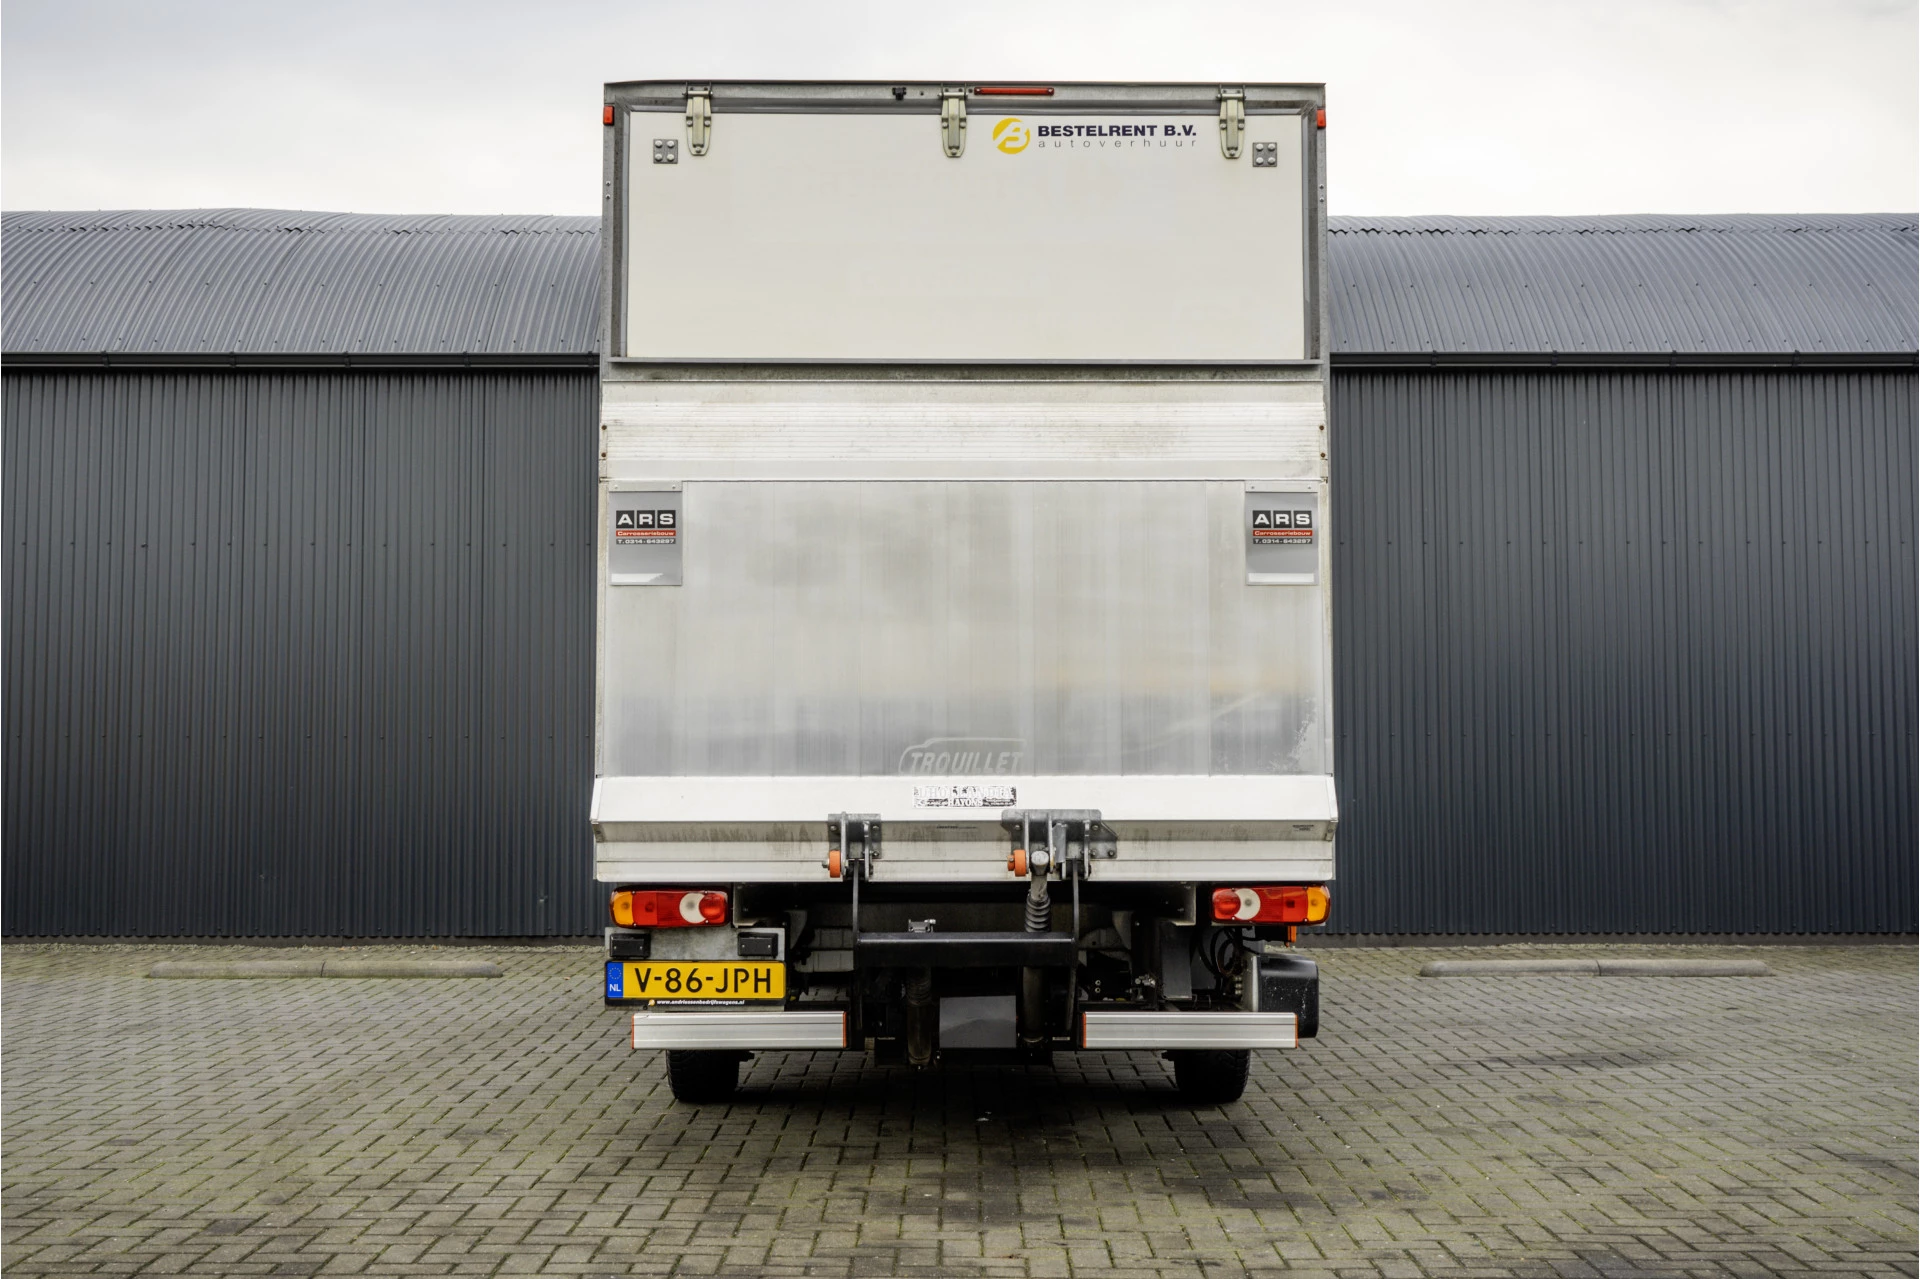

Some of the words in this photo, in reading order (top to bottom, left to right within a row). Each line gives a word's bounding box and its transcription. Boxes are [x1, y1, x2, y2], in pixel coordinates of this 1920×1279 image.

[1038, 125, 1157, 137] BESTELRENT
[1164, 125, 1197, 136] B.V.
[1038, 138, 1196, 148] autoverhuur
[617, 513, 674, 526] ARS
[1254, 513, 1311, 525] ARS
[910, 751, 1024, 775] TROUILLET
[634, 967, 771, 993] V-86-JPH
[609, 984, 621, 992] NL
